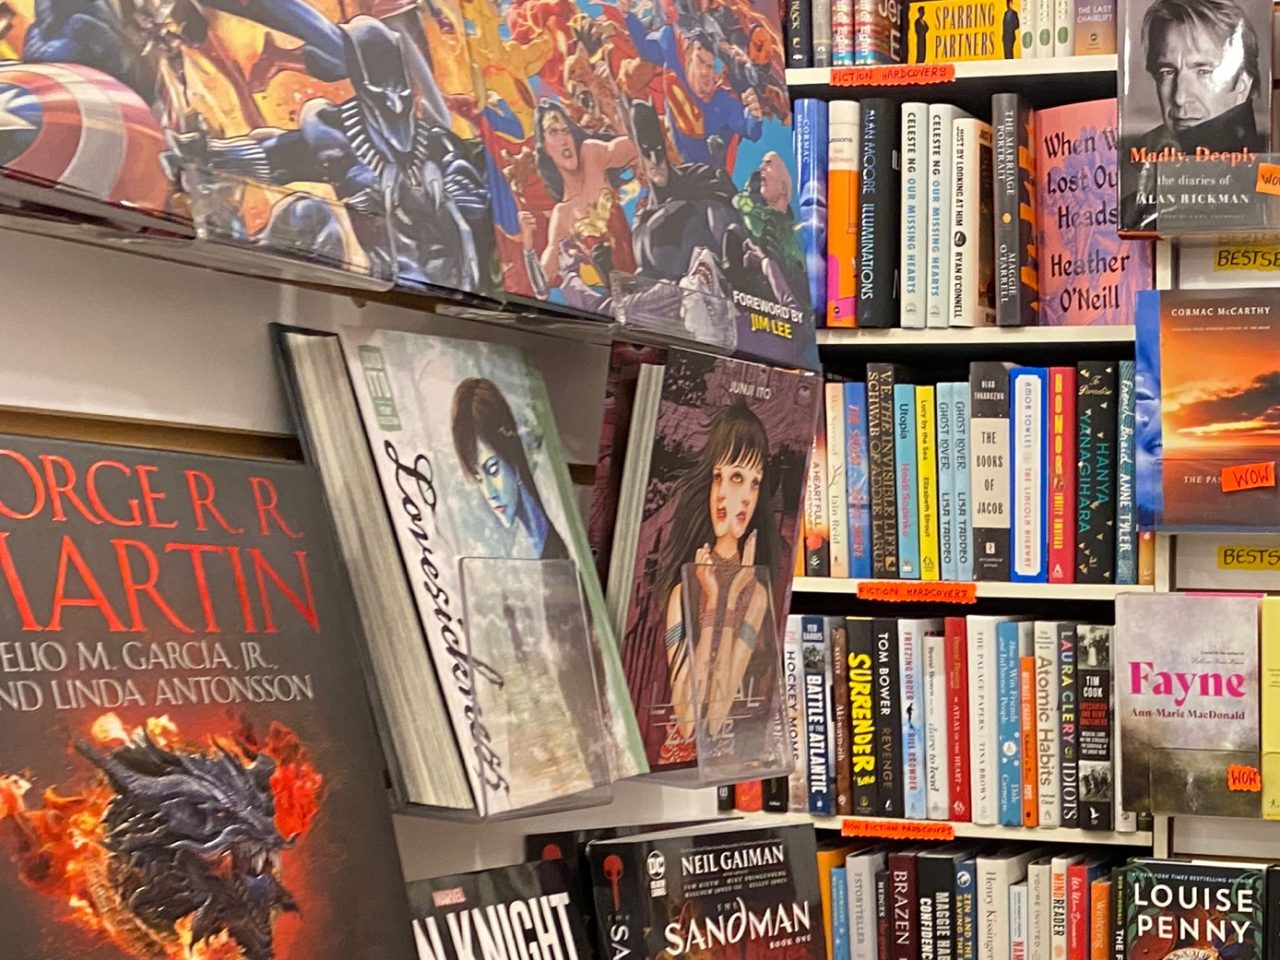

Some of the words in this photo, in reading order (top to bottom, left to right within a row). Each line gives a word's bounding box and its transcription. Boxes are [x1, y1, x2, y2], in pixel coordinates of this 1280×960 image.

[935, 4, 995, 31] SPARRING
[935, 32, 995, 59] PARTNERS
[832, 71, 873, 82] FICTION
[907, 112, 916, 154] CELESTE
[1045, 131, 1096, 159] When
[907, 158, 916, 173] NG
[1195, 147, 1258, 167] Deeply
[907, 178, 916, 200] OUR
[1048, 172, 1088, 194] Lost
[1137, 193, 1177, 205] ALAN
[1182, 193, 1249, 204] RICKMAN
[907, 205, 916, 250] MISSING
[1058, 203, 1118, 229] Heads
[861, 203, 874, 300] ILLUMINATIONS
[1051, 252, 1130, 278] Heather
[907, 255, 916, 294] HEARTS
[1060, 288, 1120, 312] O'Neill
[1171, 308, 1214, 316] CORMAC
[1218, 306, 1271, 315] McCARTHY
[751, 313, 770, 332] JIM
[771, 320, 793, 339] LEE
[791, 309, 804, 323] BY
[729, 381, 755, 396] JUNJI
[757, 386, 771, 400] ITO
[982, 431, 997, 444] THE
[976, 455, 1003, 468] BOOKS
[1078, 414, 1092, 534] YANAGIHARA
[1096, 443, 1108, 504] HANYA
[1234, 464, 1270, 487] WOW
[985, 478, 995, 491] OF
[977, 502, 1003, 515] JACOB
[384, 439, 510, 795] Lovesickness
[2, 642, 67, 672] ELIO
[78, 642, 117, 672] M.
[878, 632, 890, 663] TOM
[1060, 632, 1073, 687] LAURA
[51, 678, 145, 709] LINDA
[155, 675, 313, 704] ANTONSSON
[879, 667, 891, 716] BOWER
[1037, 654, 1051, 723] Atomic
[1084, 686, 1102, 698] COOK
[1086, 675, 1099, 687] TIM
[1129, 661, 1246, 706] Fayne
[806, 675, 823, 724] BATTLE
[848, 652, 876, 771] SURRENDER
[1130, 707, 1185, 719] Ann-Marie
[1187, 708, 1245, 720] MacDonald
[1062, 692, 1074, 744] CLERY
[809, 732, 827, 794] ATLANTIC
[1039, 728, 1053, 786] Habits
[1232, 771, 1258, 785] WOW
[681, 856, 719, 876] NEIL
[720, 845, 784, 871] GAIMAN
[893, 871, 909, 945] BRAZEN
[1134, 883, 1253, 913] LOUISE
[665, 897, 810, 956] SANDMAN
[936, 892, 950, 936] MAGGIE
[1115, 929, 1124, 949] THE
[1137, 916, 1251, 944] PENNY
